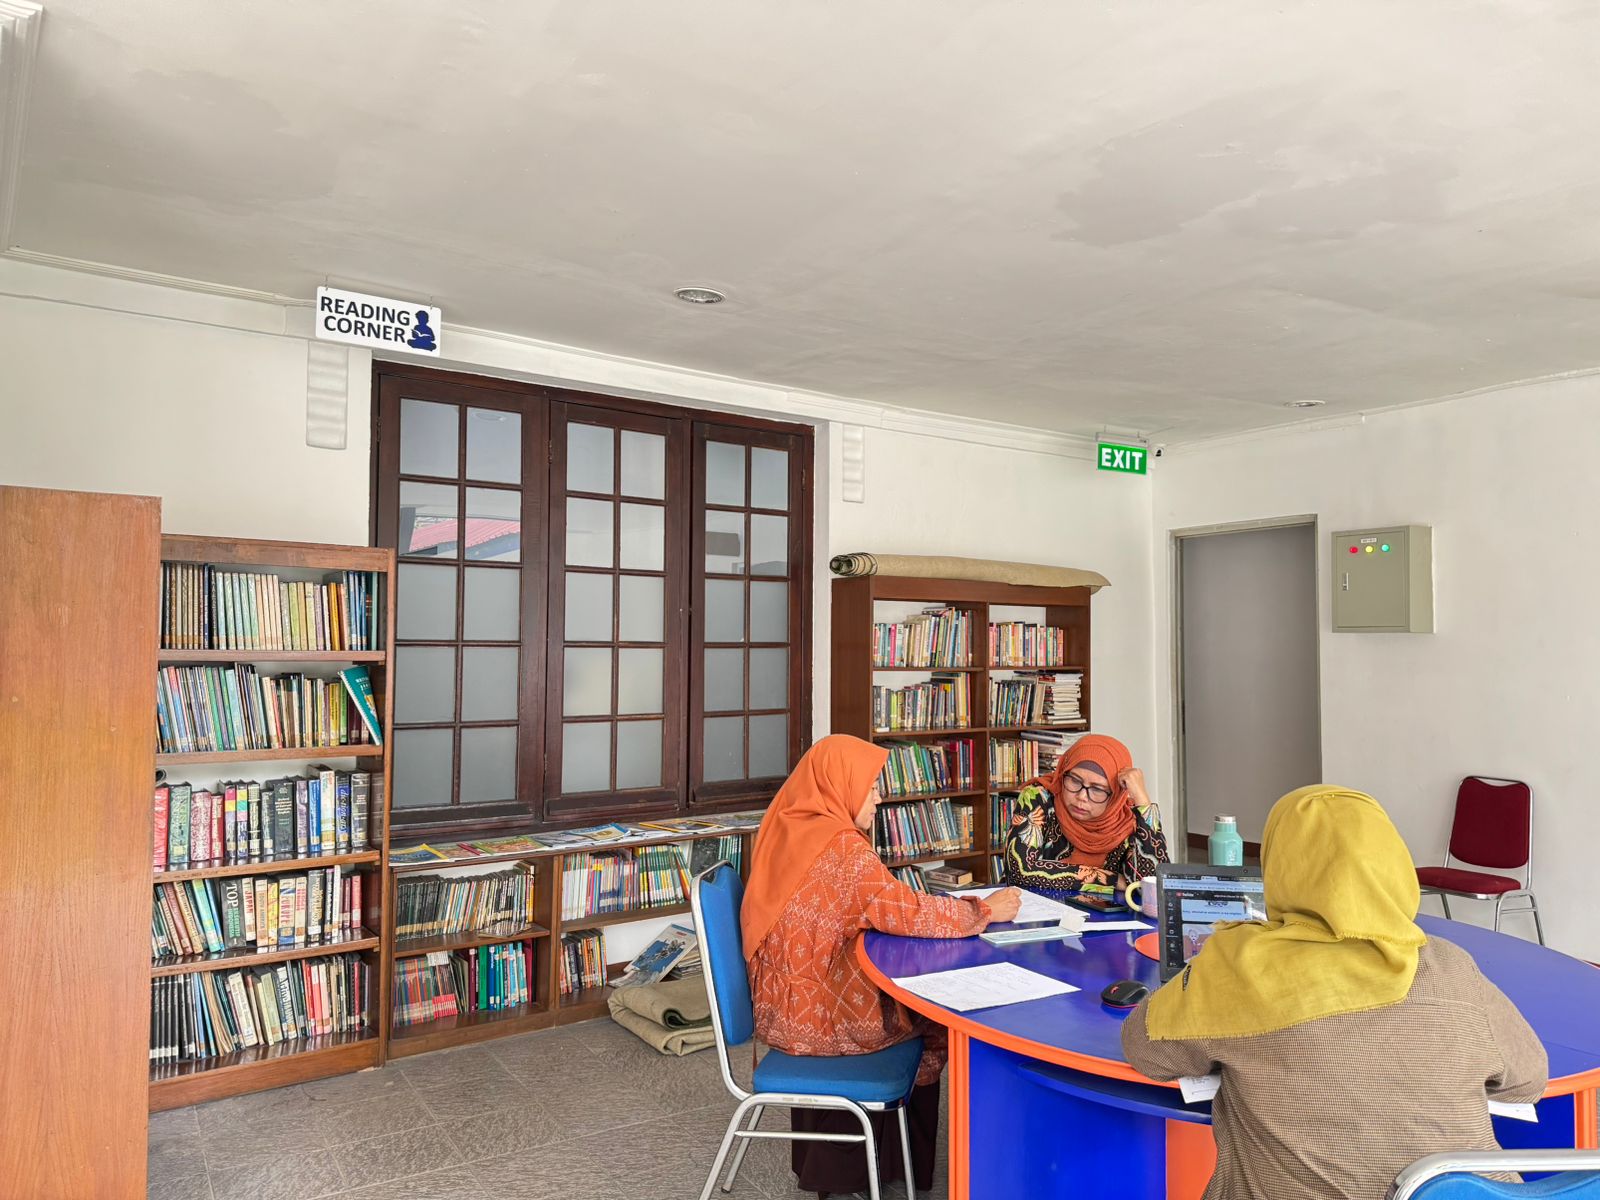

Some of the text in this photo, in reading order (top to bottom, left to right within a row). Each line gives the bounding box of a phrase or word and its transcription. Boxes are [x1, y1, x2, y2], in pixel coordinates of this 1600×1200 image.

[320, 296, 410, 326] READING
[324, 315, 405, 343] CORNER
[1101, 447, 1143, 470] EXIT
[226, 883, 239, 907] TOP
[244, 890, 254, 914] JAPAN
